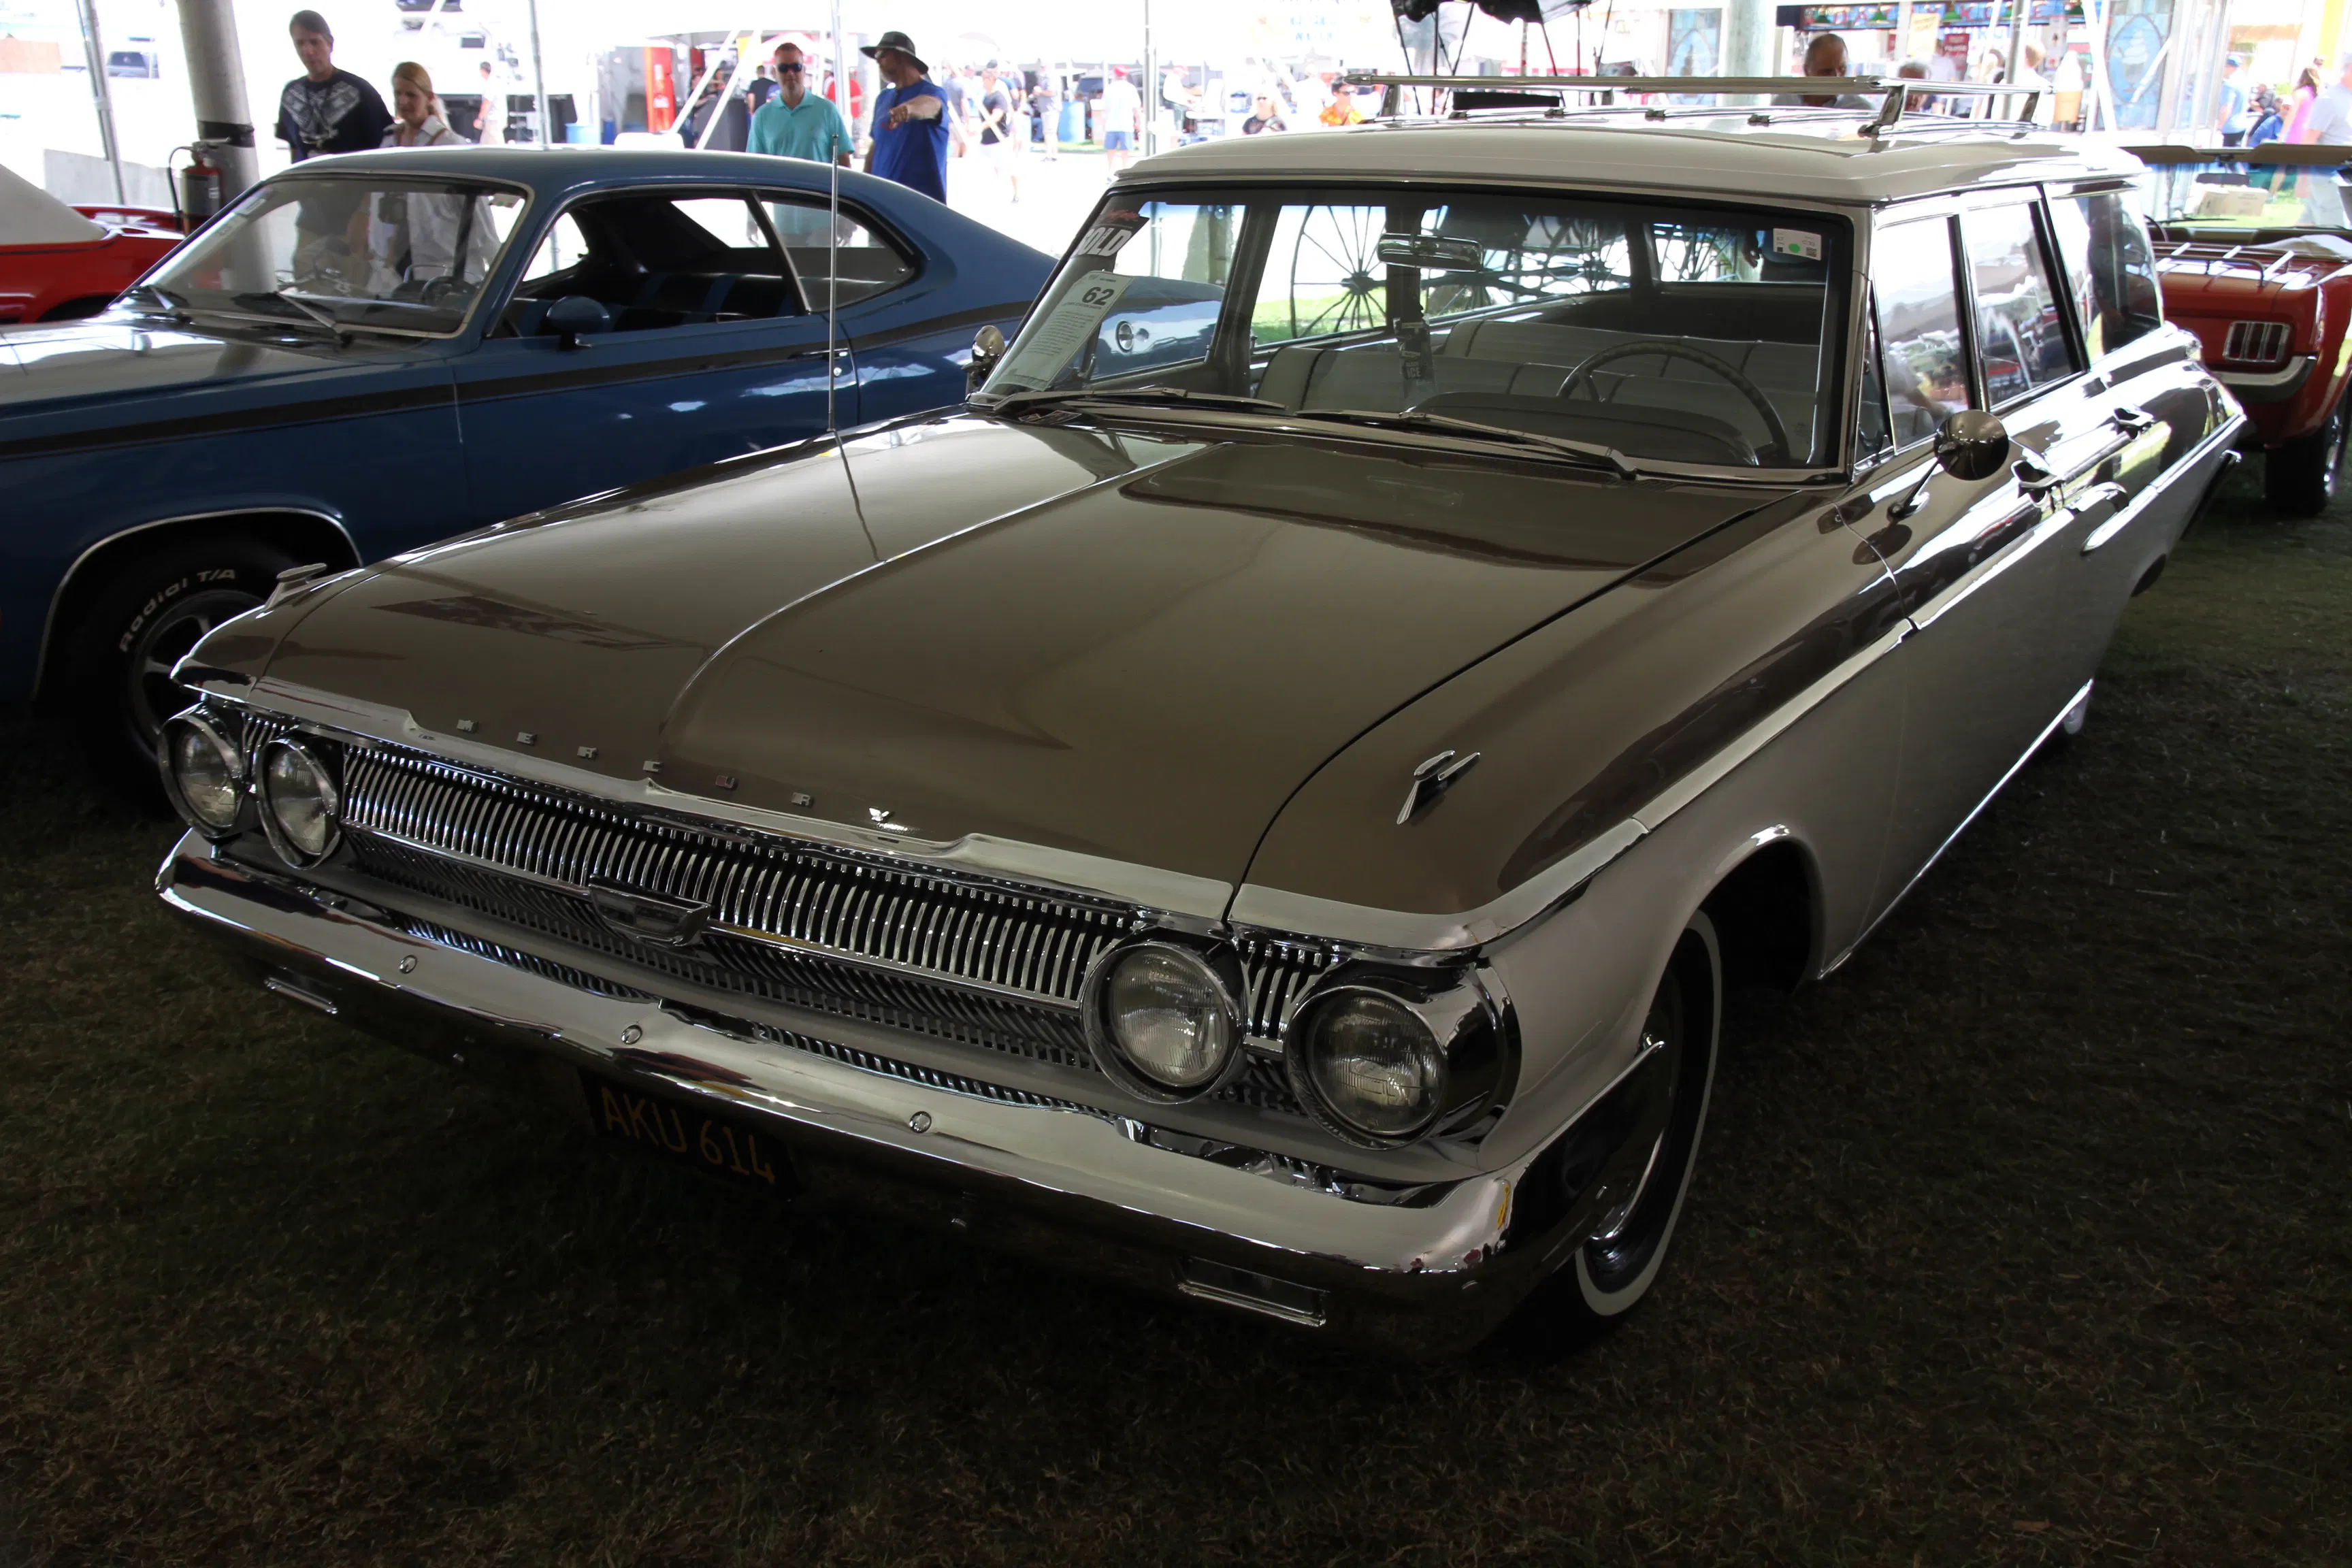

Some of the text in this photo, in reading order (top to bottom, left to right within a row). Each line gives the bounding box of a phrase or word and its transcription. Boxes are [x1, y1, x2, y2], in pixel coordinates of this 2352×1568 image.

[1077, 227, 1131, 257] SOLD
[1082, 287, 1114, 306] 62
[119, 568, 236, 652] Radial T/A
[602, 1087, 775, 1183] AKU 614
